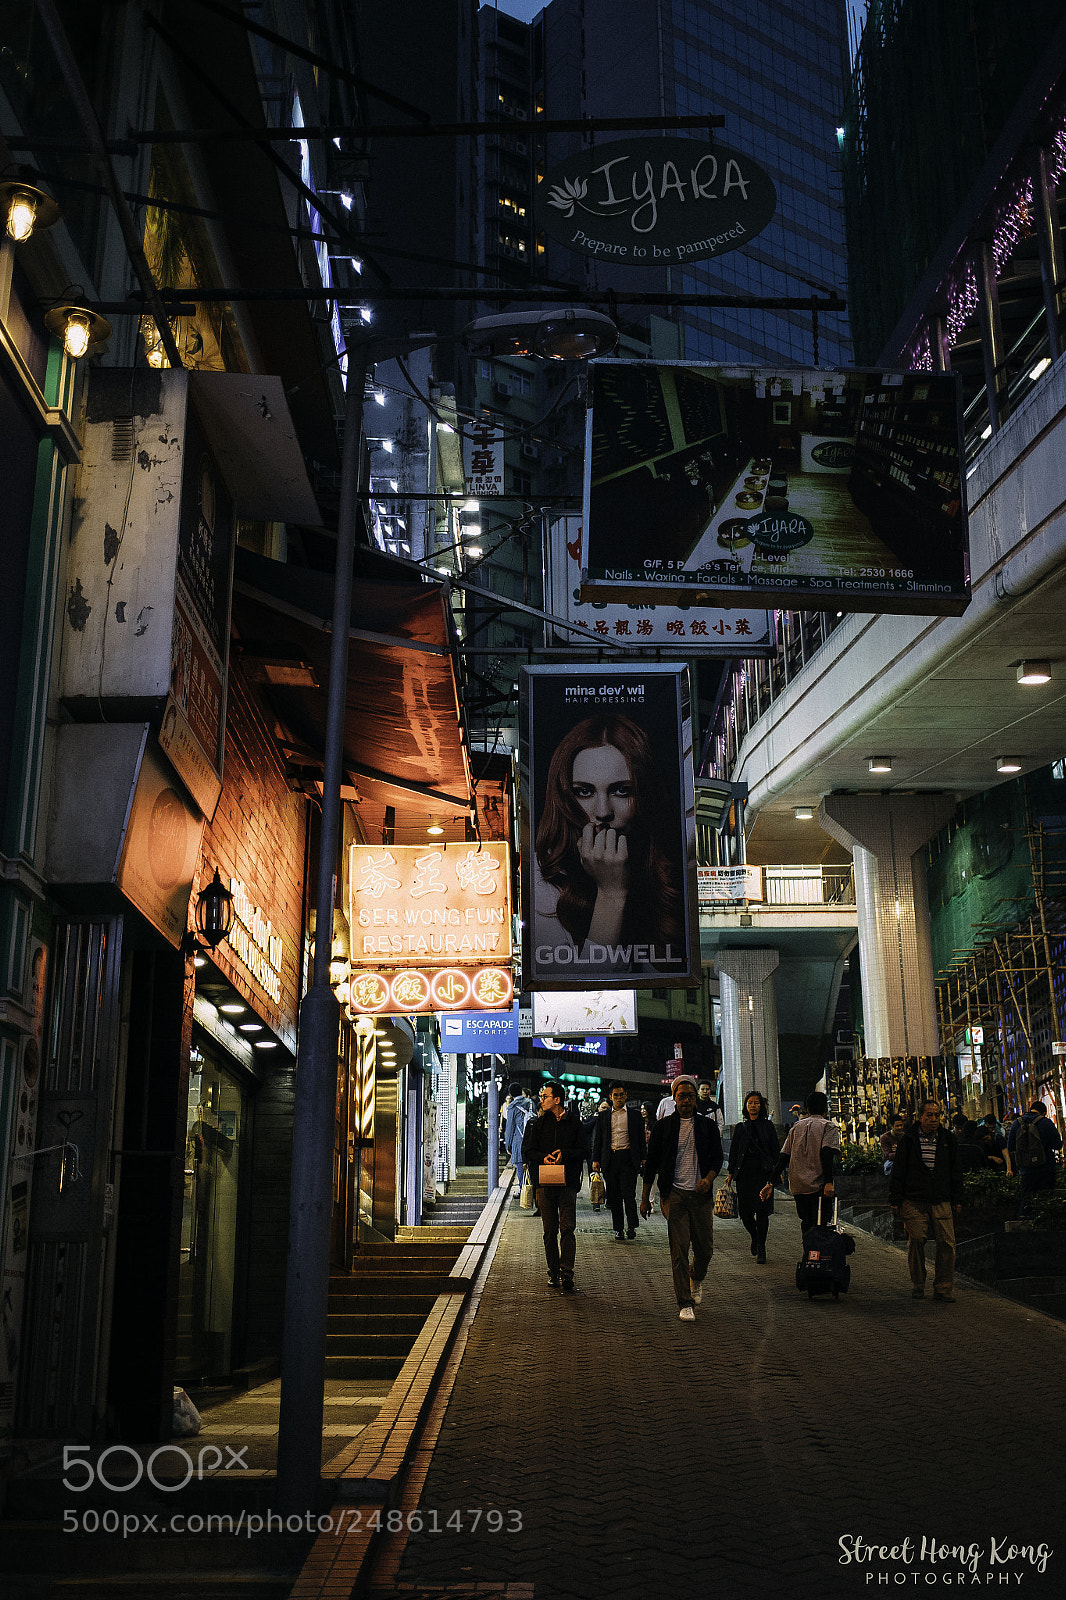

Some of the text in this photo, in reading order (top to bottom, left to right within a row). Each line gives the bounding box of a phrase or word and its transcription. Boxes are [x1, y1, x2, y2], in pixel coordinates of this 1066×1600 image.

[591, 154, 750, 233] IYARA
[571, 221, 747, 260] Prepare to be pampered
[469, 483, 498, 491] LINVA
[759, 517, 807, 543] IYARA
[643, 559, 665, 571] G/F,
[667, 560, 675, 570] 5
[838, 567, 857, 577] Tel:
[859, 568, 886, 578] 2530
[889, 569, 914, 579] 1666
[605, 569, 952, 593] Nails Waxing Facials Massage Spa Treatments Slimming
[666, 617, 753, 637] 晚飯小菜
[565, 684, 645, 696] mina dev' wil
[594, 696, 646, 704] DRESSING
[359, 907, 505, 926] SER WONG FUN
[363, 933, 500, 954] RESTAURANT
[535, 943, 682, 965] GOLDWELL
[353, 970, 508, 1006] 晚飯小菜
[466, 1020, 514, 1029] ESCAPADE
